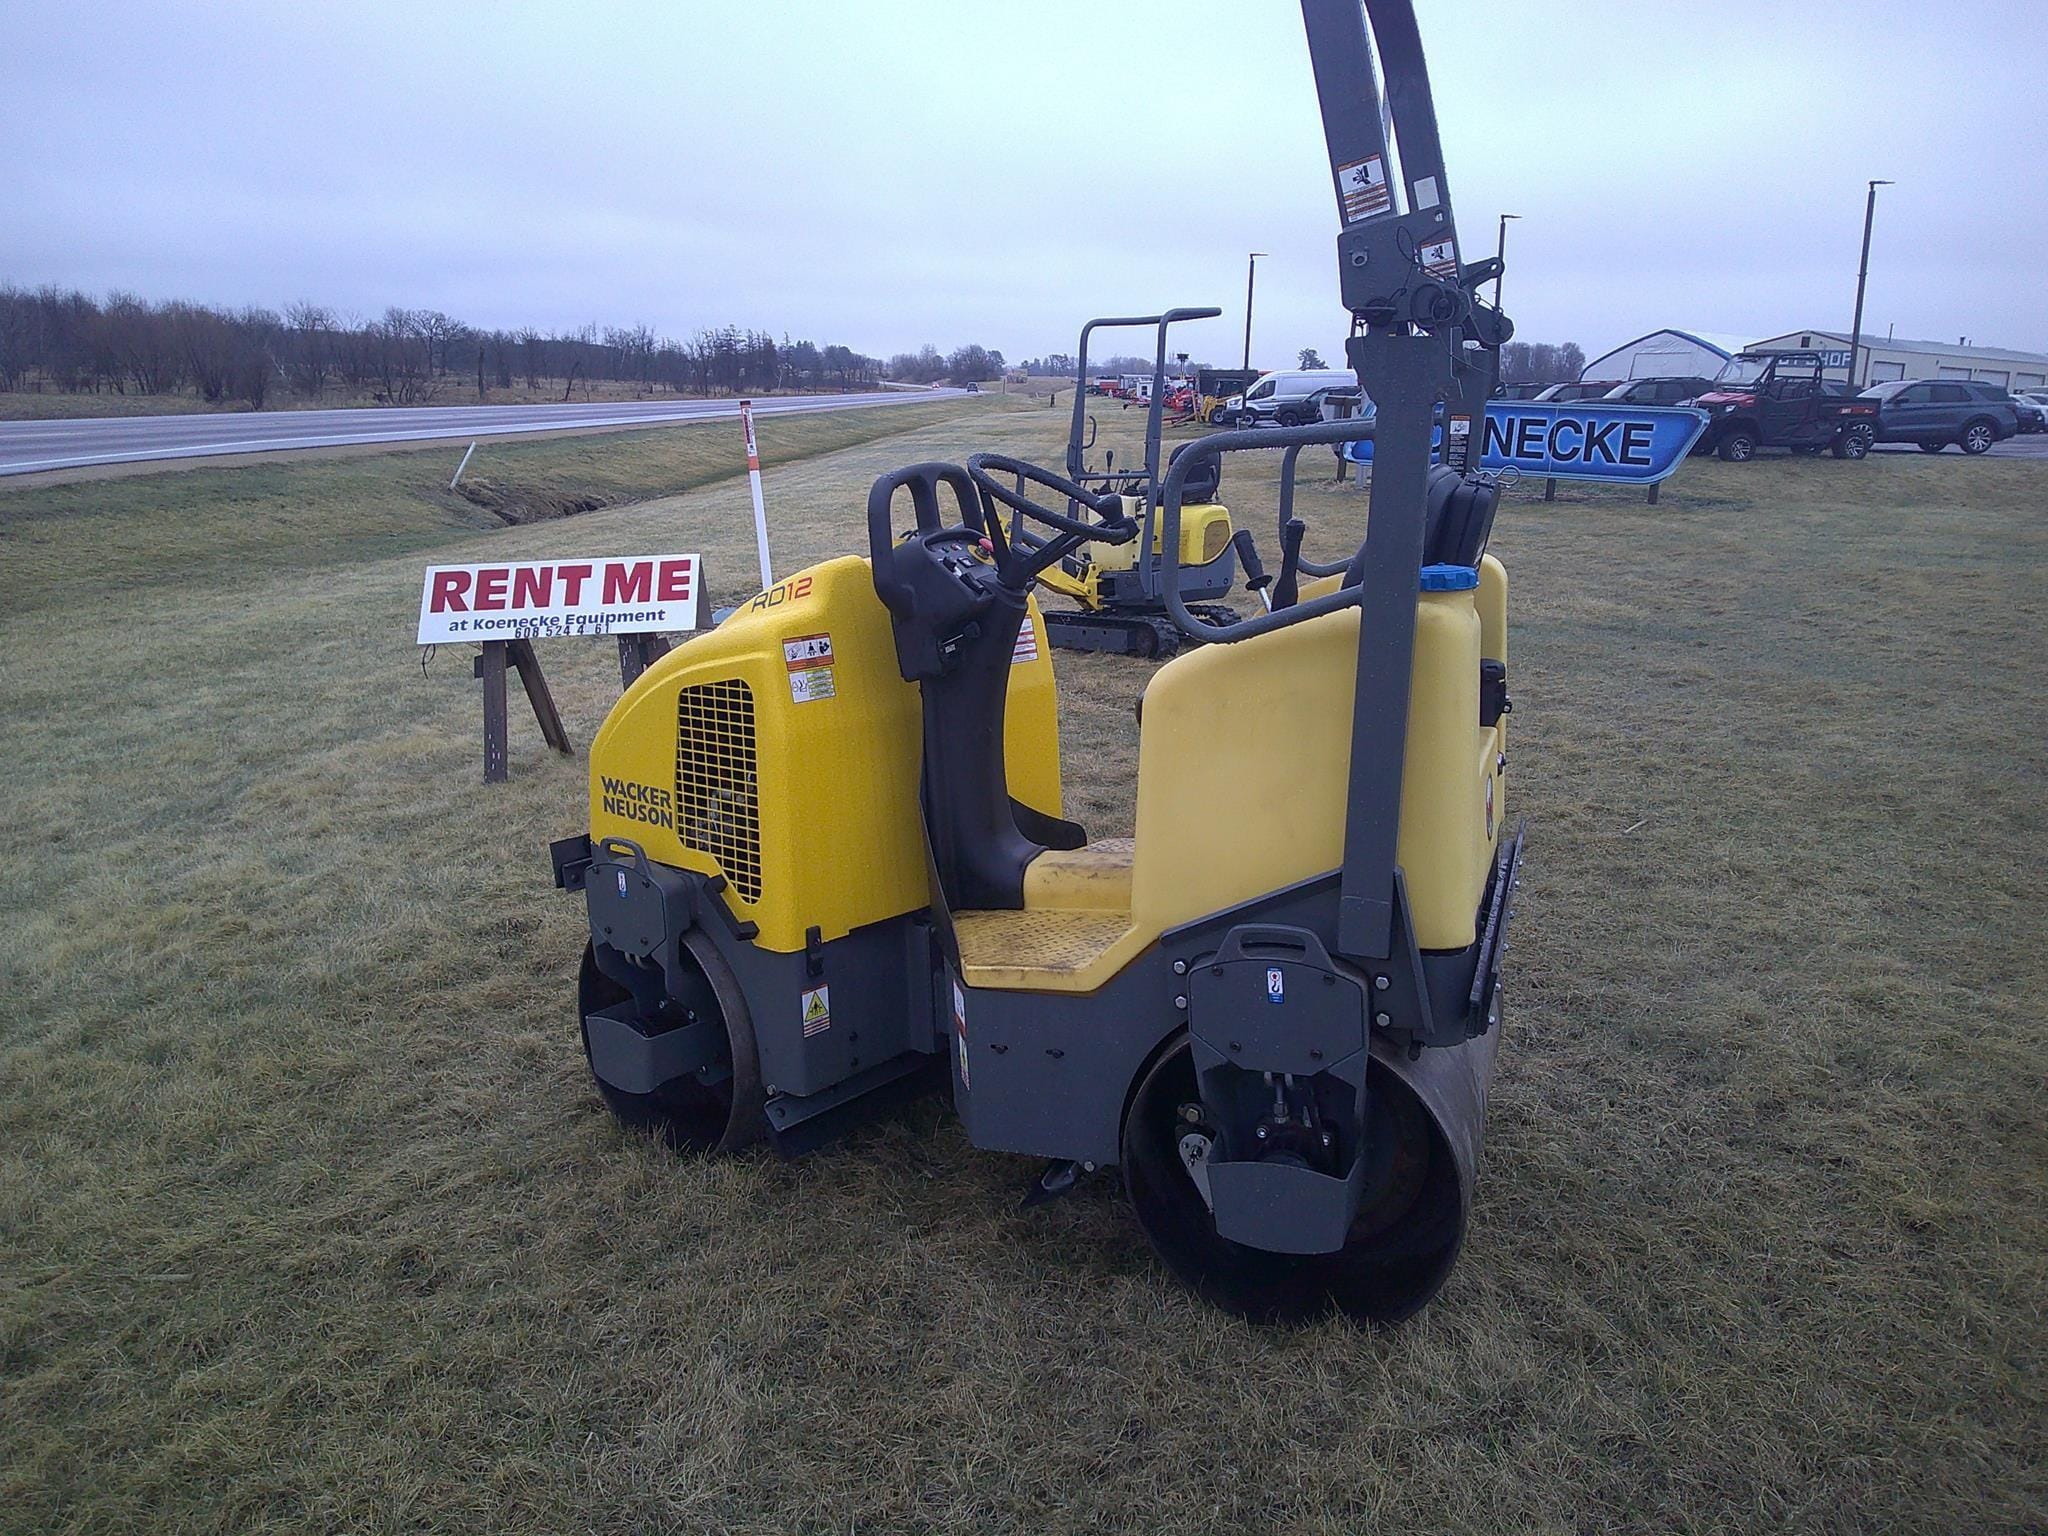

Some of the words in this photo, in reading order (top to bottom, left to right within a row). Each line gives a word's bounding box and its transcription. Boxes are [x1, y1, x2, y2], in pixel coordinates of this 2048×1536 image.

[1482, 416, 1654, 466] NECKE
[429, 564, 593, 614] RENT
[602, 558, 692, 605] ME
[751, 576, 813, 613] RD12
[449, 619, 468, 632] at
[473, 615, 560, 631] Koenecke
[565, 608, 666, 627] Equipment
[514, 626, 539, 639] 608
[546, 624, 571, 637] 524
[600, 775, 673, 810] WACKER
[603, 795, 673, 830] NEUSON
